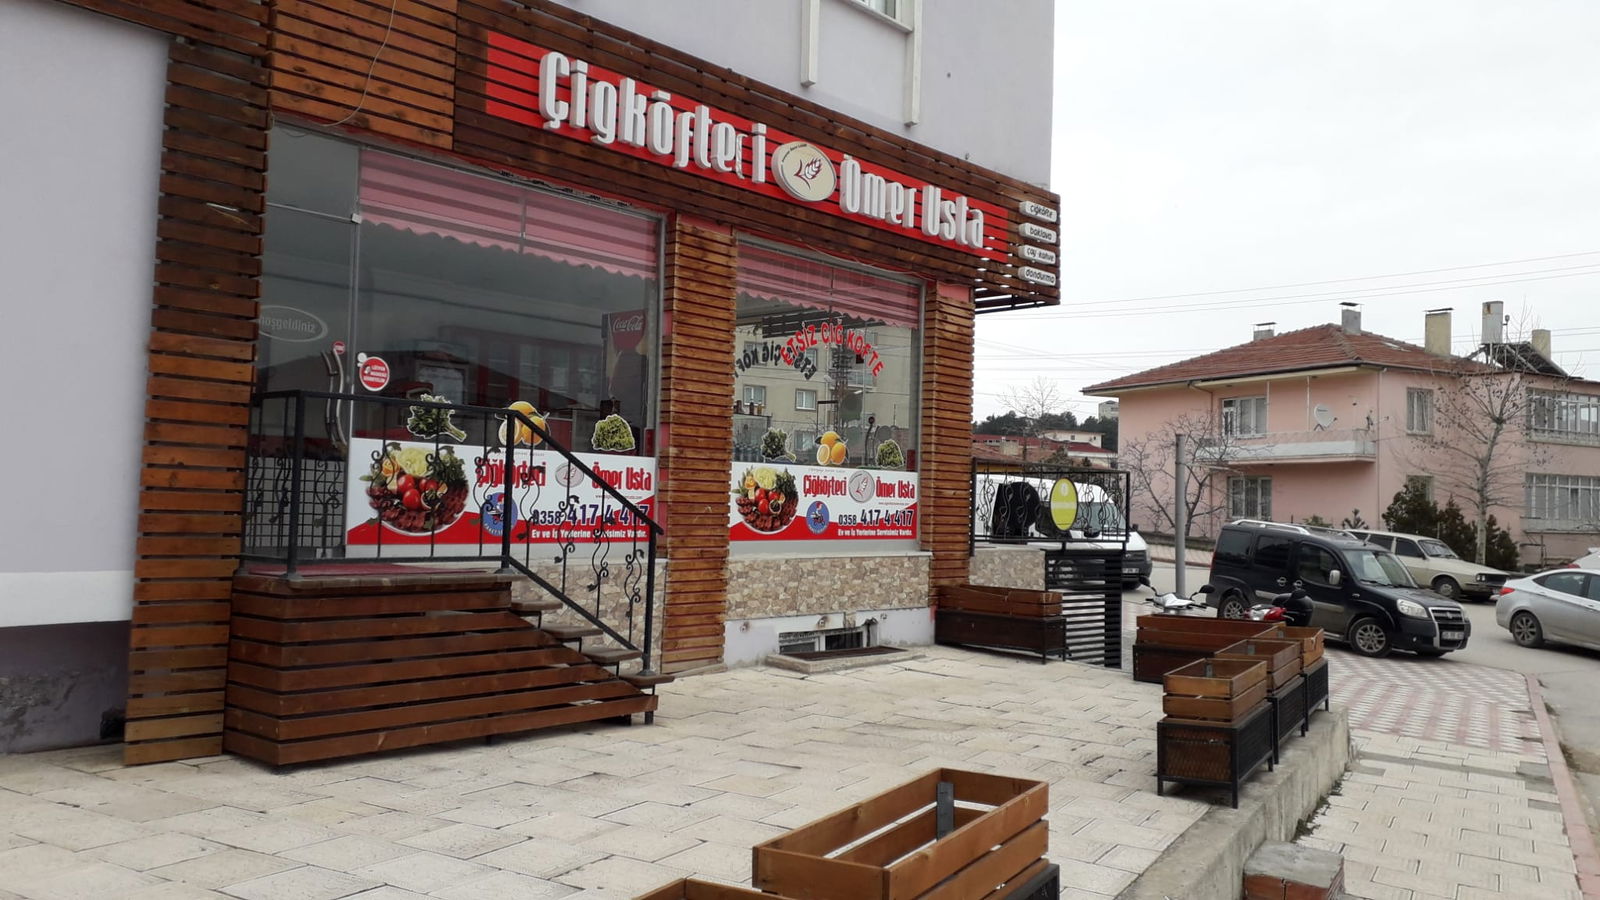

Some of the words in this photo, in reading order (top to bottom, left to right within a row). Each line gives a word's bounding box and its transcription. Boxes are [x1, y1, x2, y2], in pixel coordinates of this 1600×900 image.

[839, 154, 917, 228] Ömer
[922, 185, 985, 249] Usta
[1030, 227, 1052, 240] baklava
[1025, 269, 1055, 284] dondurma
[626, 467, 651, 491] Usta
[876, 476, 896, 498] Ömer
[898, 480, 915, 499] Usta
[567, 503, 599, 525] 417
[604, 504, 617, 525] 4
[838, 514, 857, 525] 0358
[860, 509, 881, 525] 417
[884, 510, 891, 525] 4
[894, 510, 913, 526] 417
[531, 529, 540, 538] Ev
[541, 530, 551, 538] ve
